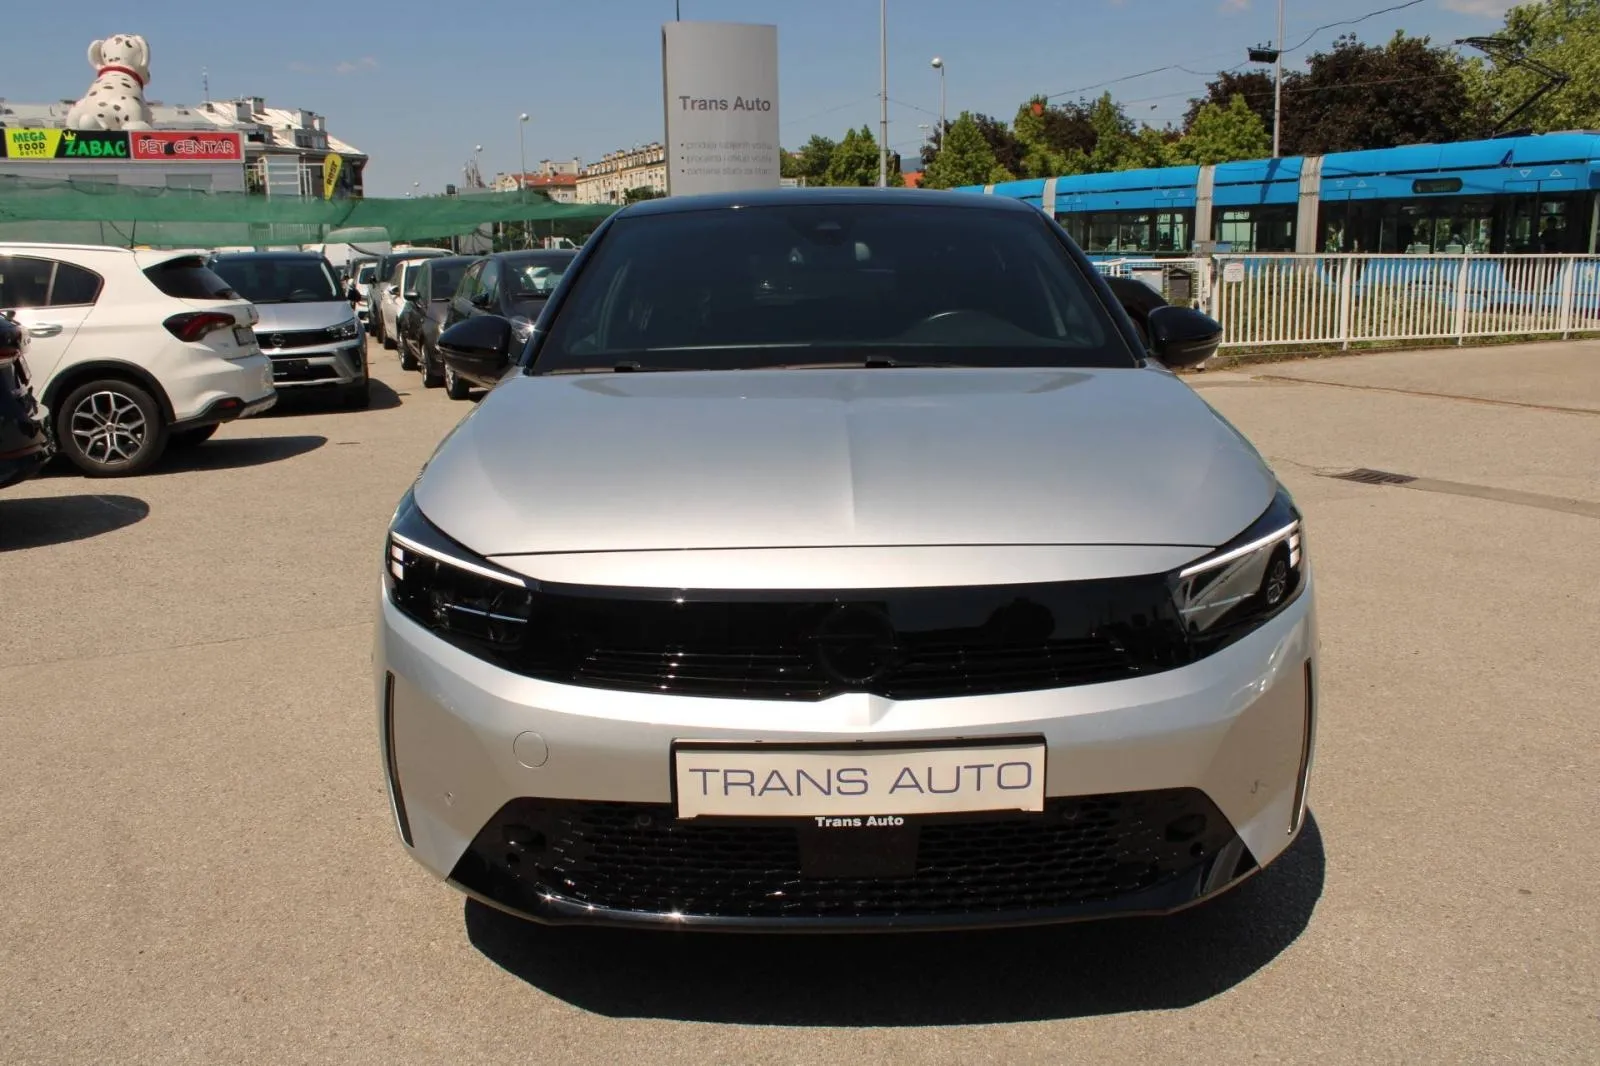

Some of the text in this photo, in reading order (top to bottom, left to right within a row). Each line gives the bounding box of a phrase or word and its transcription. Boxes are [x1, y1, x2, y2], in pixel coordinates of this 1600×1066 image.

[679, 96, 771, 111] Trans Auto
[13, 131, 47, 143] MEGA
[18, 142, 45, 151] FOOD
[138, 139, 235, 154] PET CENTAR
[689, 762, 1032, 796] TRANS AUTO
[815, 815, 904, 827] Trans Auto
